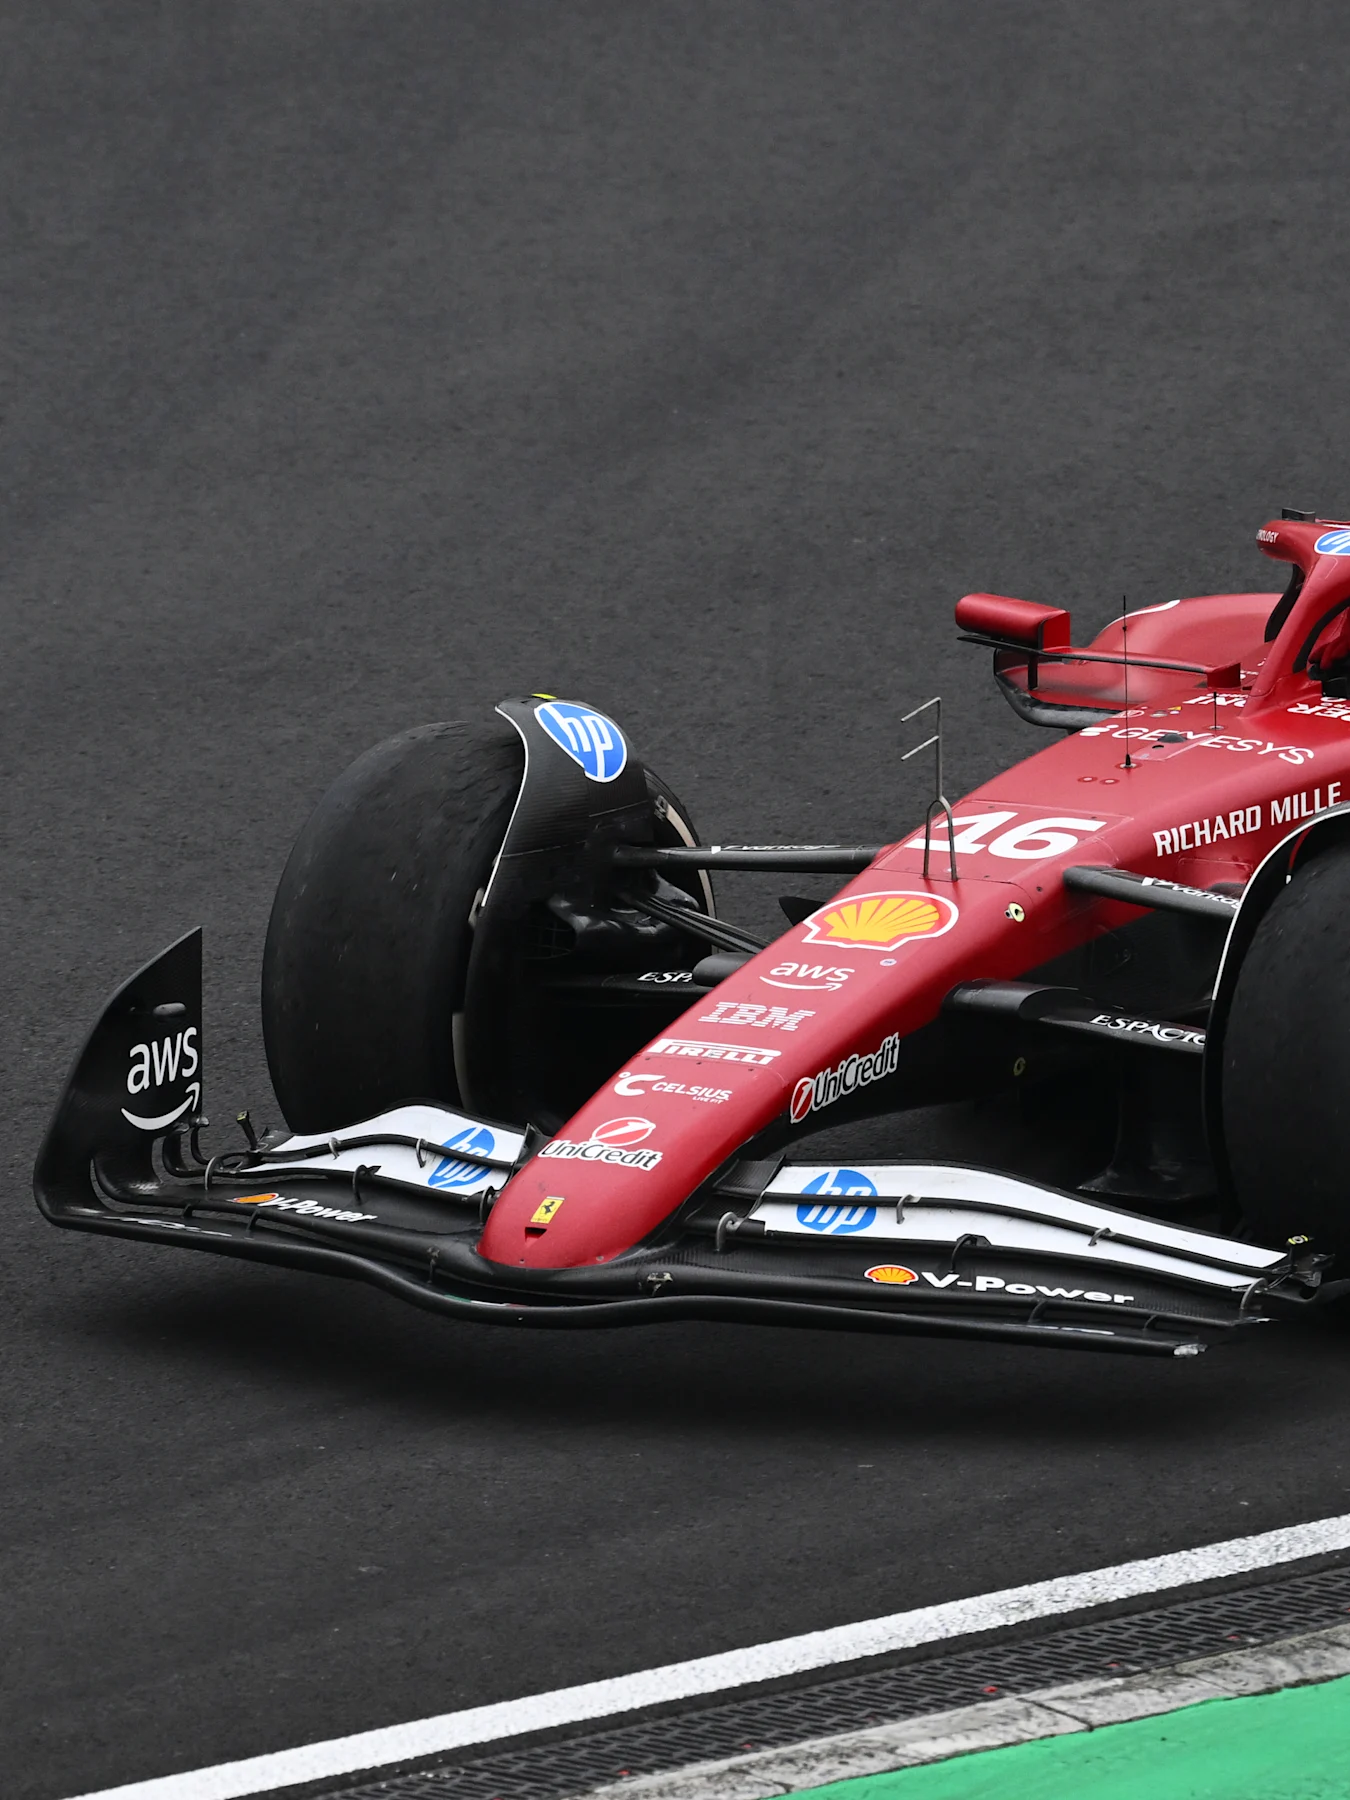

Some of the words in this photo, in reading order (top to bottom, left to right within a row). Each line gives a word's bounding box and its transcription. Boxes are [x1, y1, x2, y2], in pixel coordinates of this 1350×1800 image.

[539, 703, 618, 781] hp
[1111, 727, 1314, 765] GENESYS
[904, 811, 1107, 859] 16
[1152, 805, 1261, 857] RICHARD
[1271, 782, 1341, 826] MILLE
[770, 962, 855, 983] aws
[698, 1001, 816, 1031] IBM
[127, 1027, 198, 1094] aws
[647, 1039, 782, 1065] PIRELLI
[651, 1081, 733, 1099] CELSIUS
[813, 1035, 898, 1110] UniCredit
[433, 1127, 491, 1188] hp
[541, 1141, 660, 1169] UniCredit
[272, 1196, 377, 1223] V-Power
[800, 1169, 874, 1234] hp
[921, 1271, 1135, 1304] V-Power
